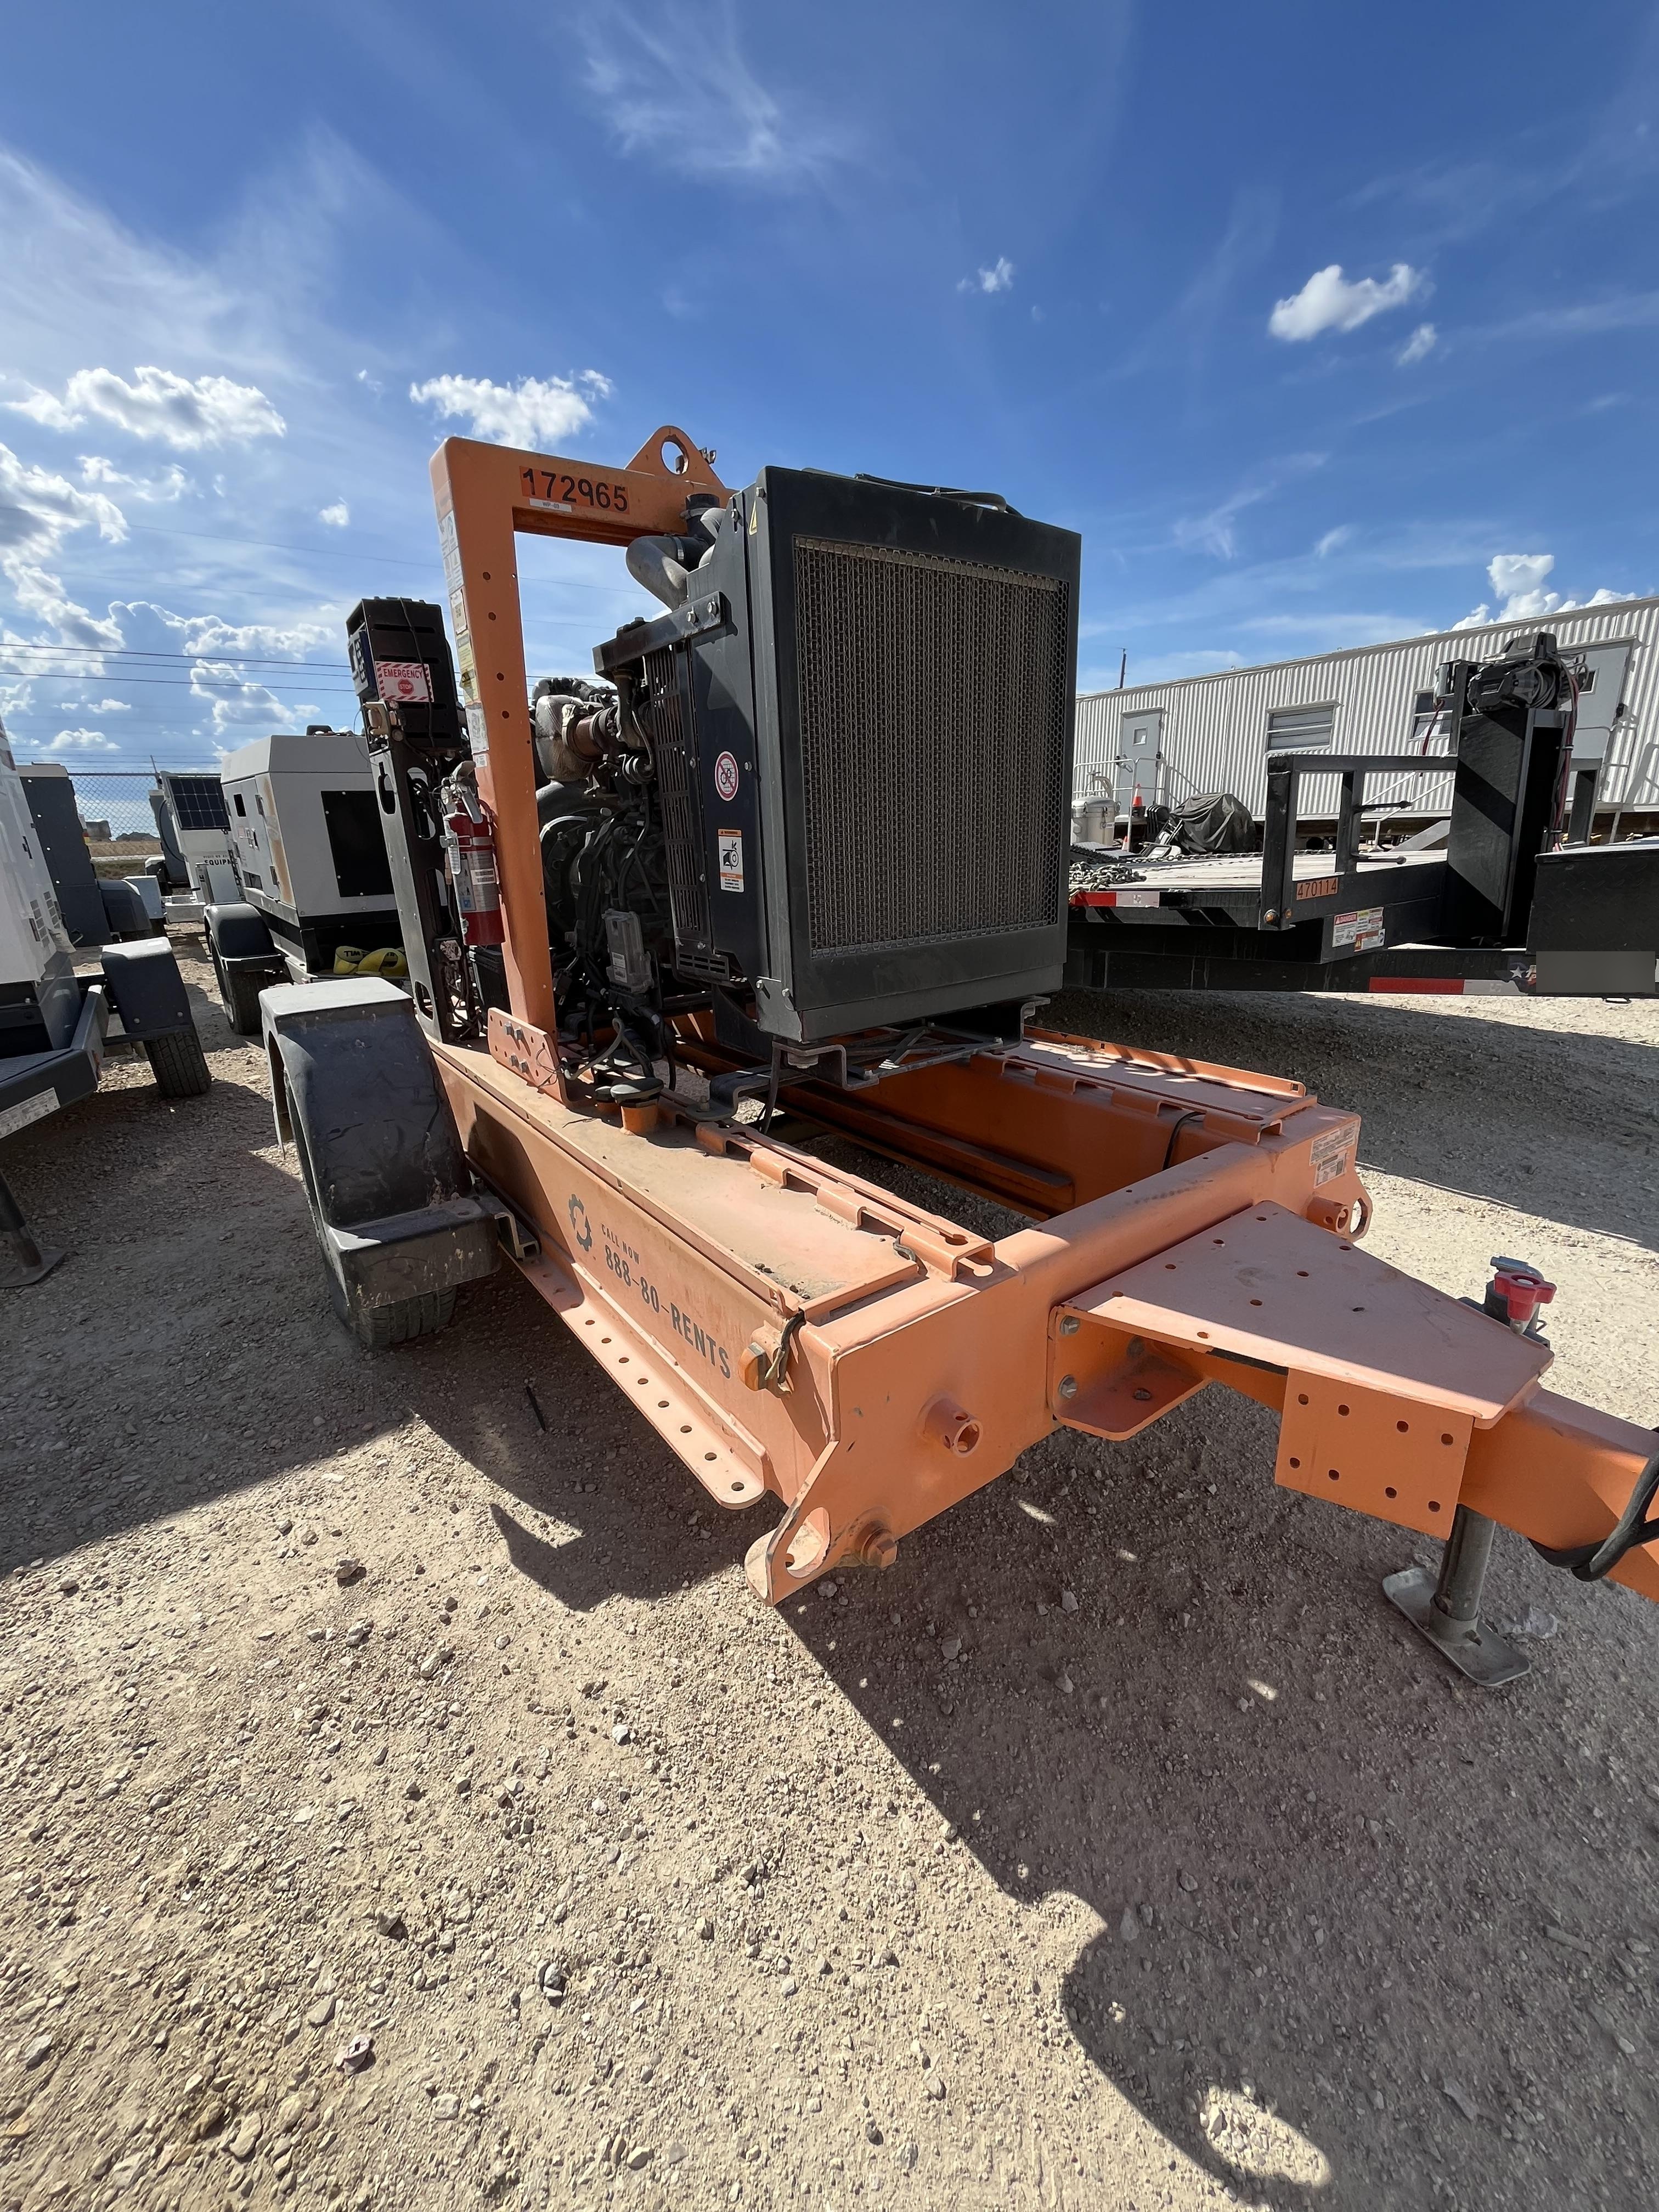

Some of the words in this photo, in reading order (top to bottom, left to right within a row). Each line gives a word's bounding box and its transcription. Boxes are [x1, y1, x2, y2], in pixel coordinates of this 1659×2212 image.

[523, 468, 628, 512] 172965
[383, 668, 423, 679] EMERGENCY
[1297, 878, 1337, 898] 470114
[601, 1223, 619, 1248] CALL
[623, 1243, 639, 1265] NOW
[605, 1244, 730, 1379] 888-80-RENTS
